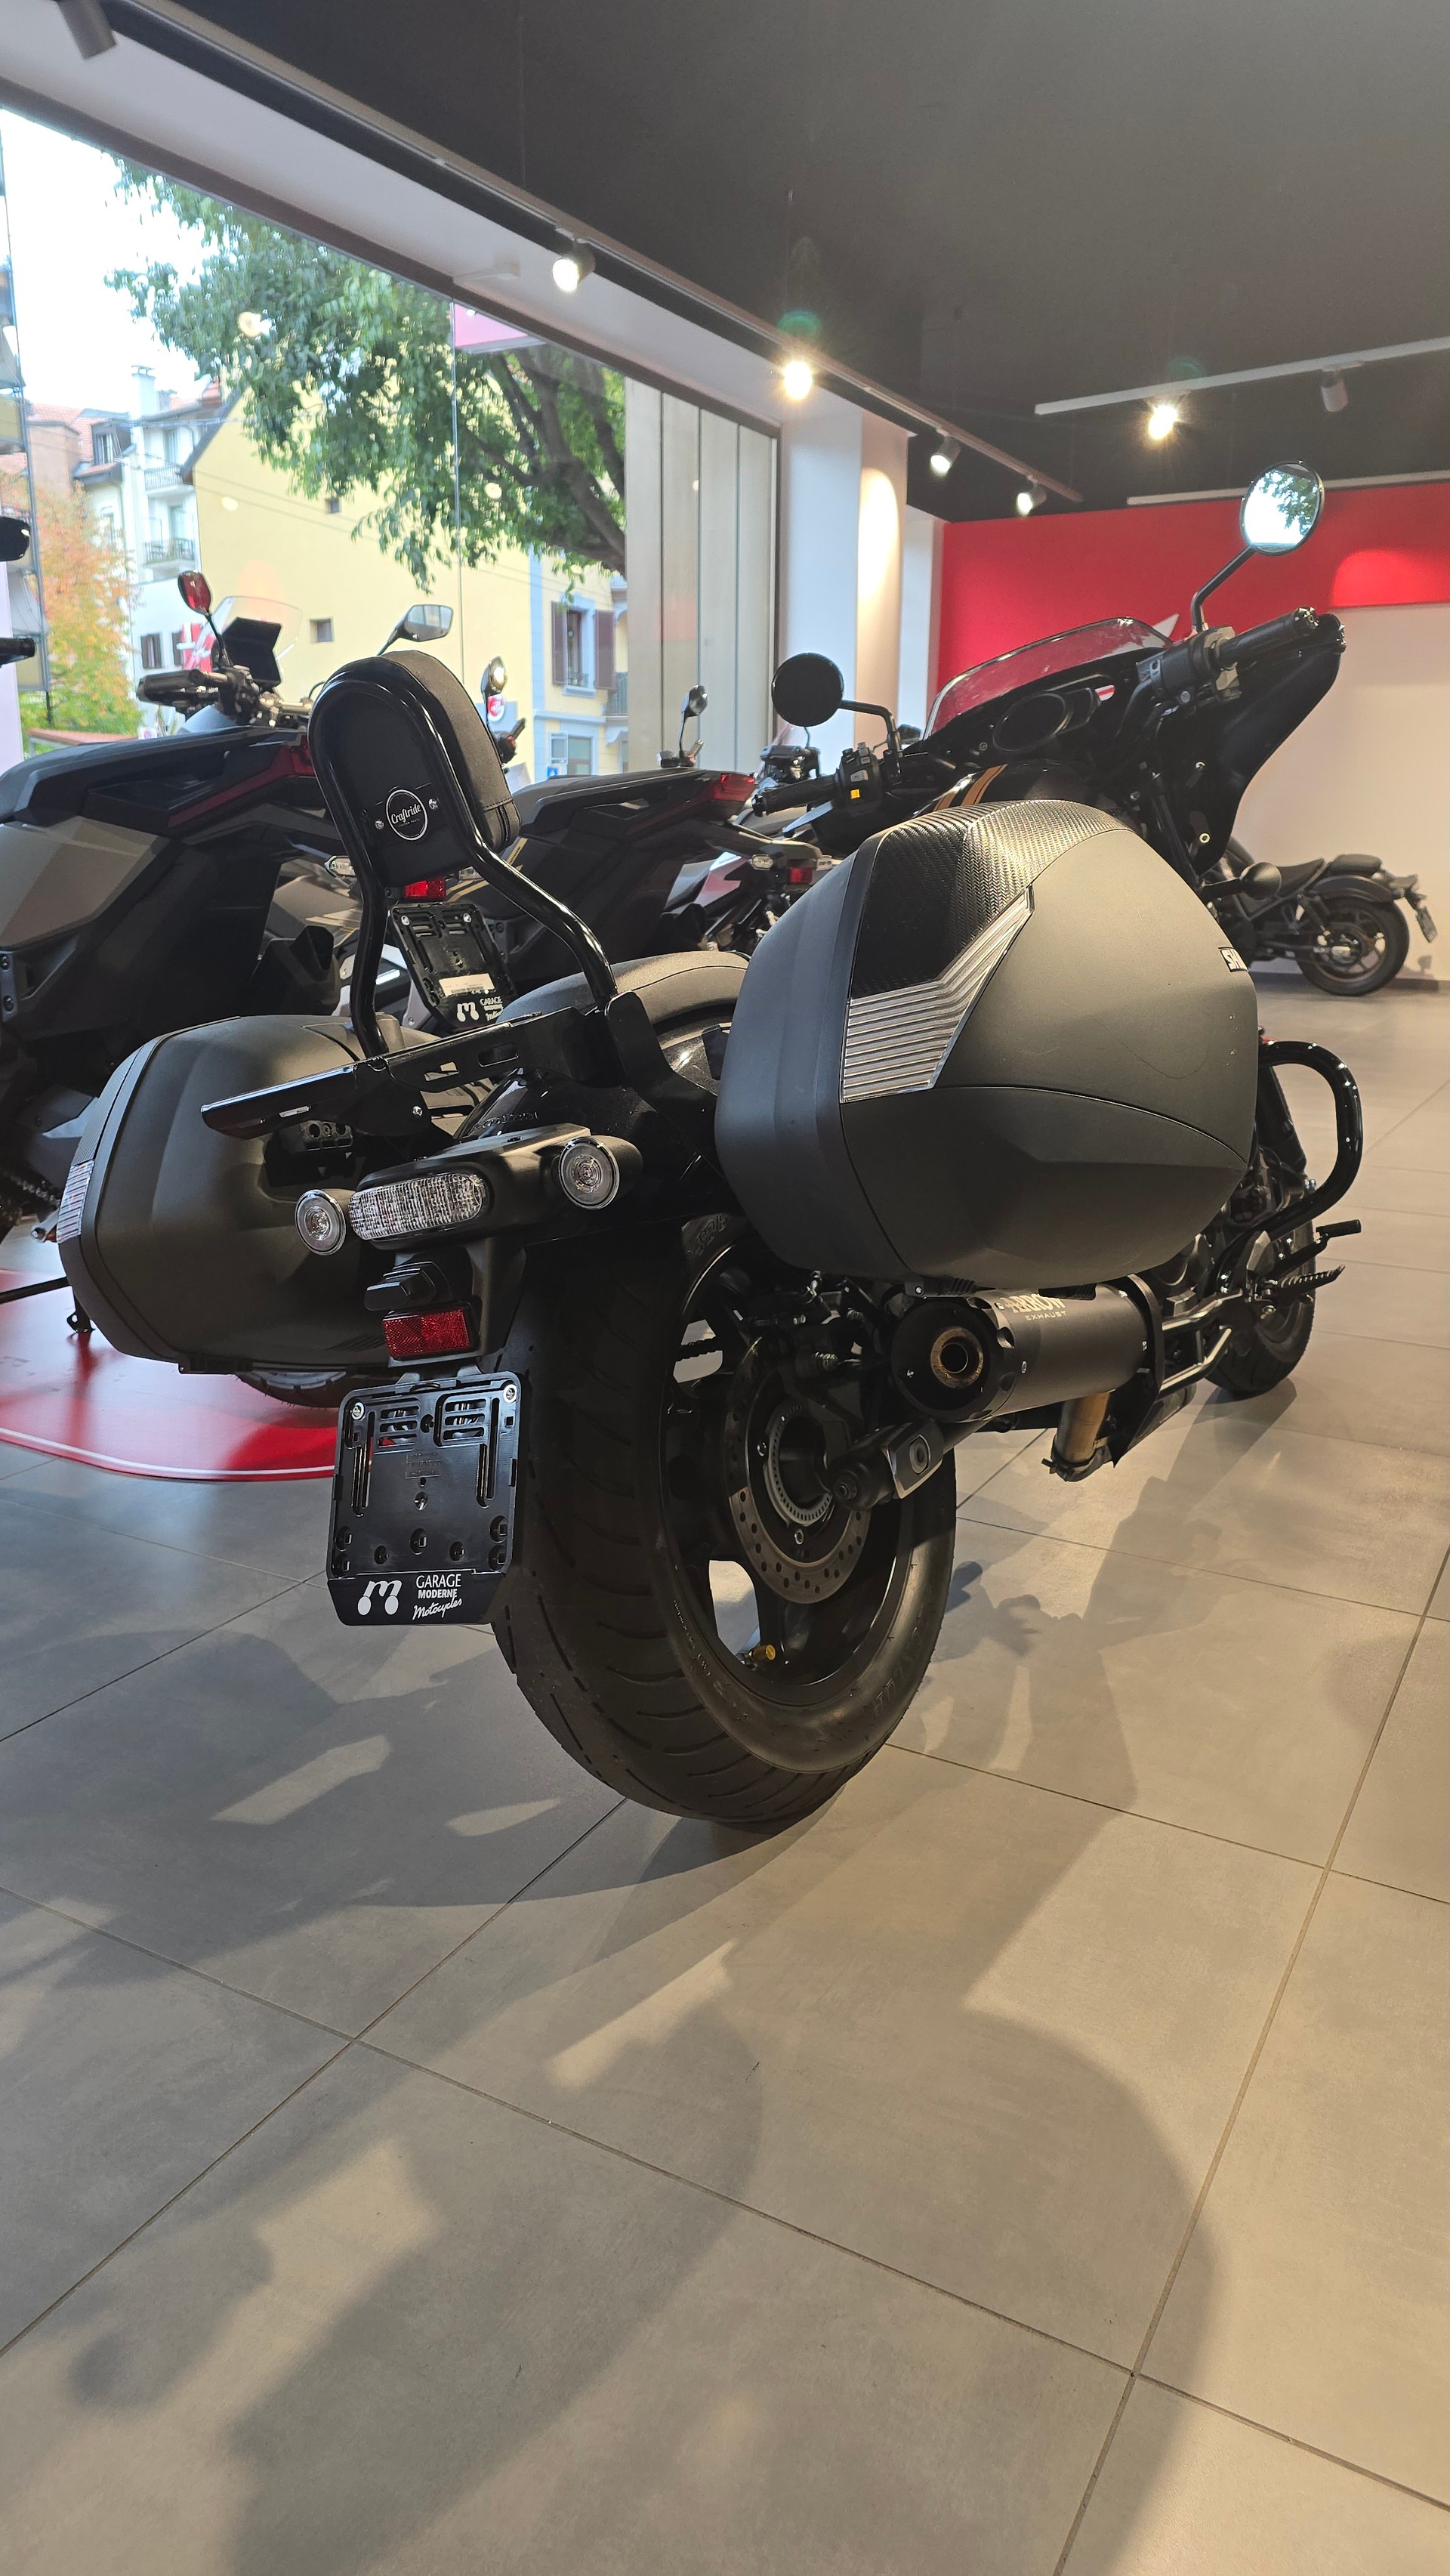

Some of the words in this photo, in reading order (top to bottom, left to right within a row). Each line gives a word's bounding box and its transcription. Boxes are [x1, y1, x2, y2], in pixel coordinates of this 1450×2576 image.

[391, 803, 421, 824] Craftride
[1220, 949, 1248, 970] SH
[1025, 1311, 1066, 1320] EXHAUST
[416, 1574, 461, 1589] GARAGE
[418, 1588, 458, 1599] MODERNE
[412, 1594, 463, 1620] Motocycles
